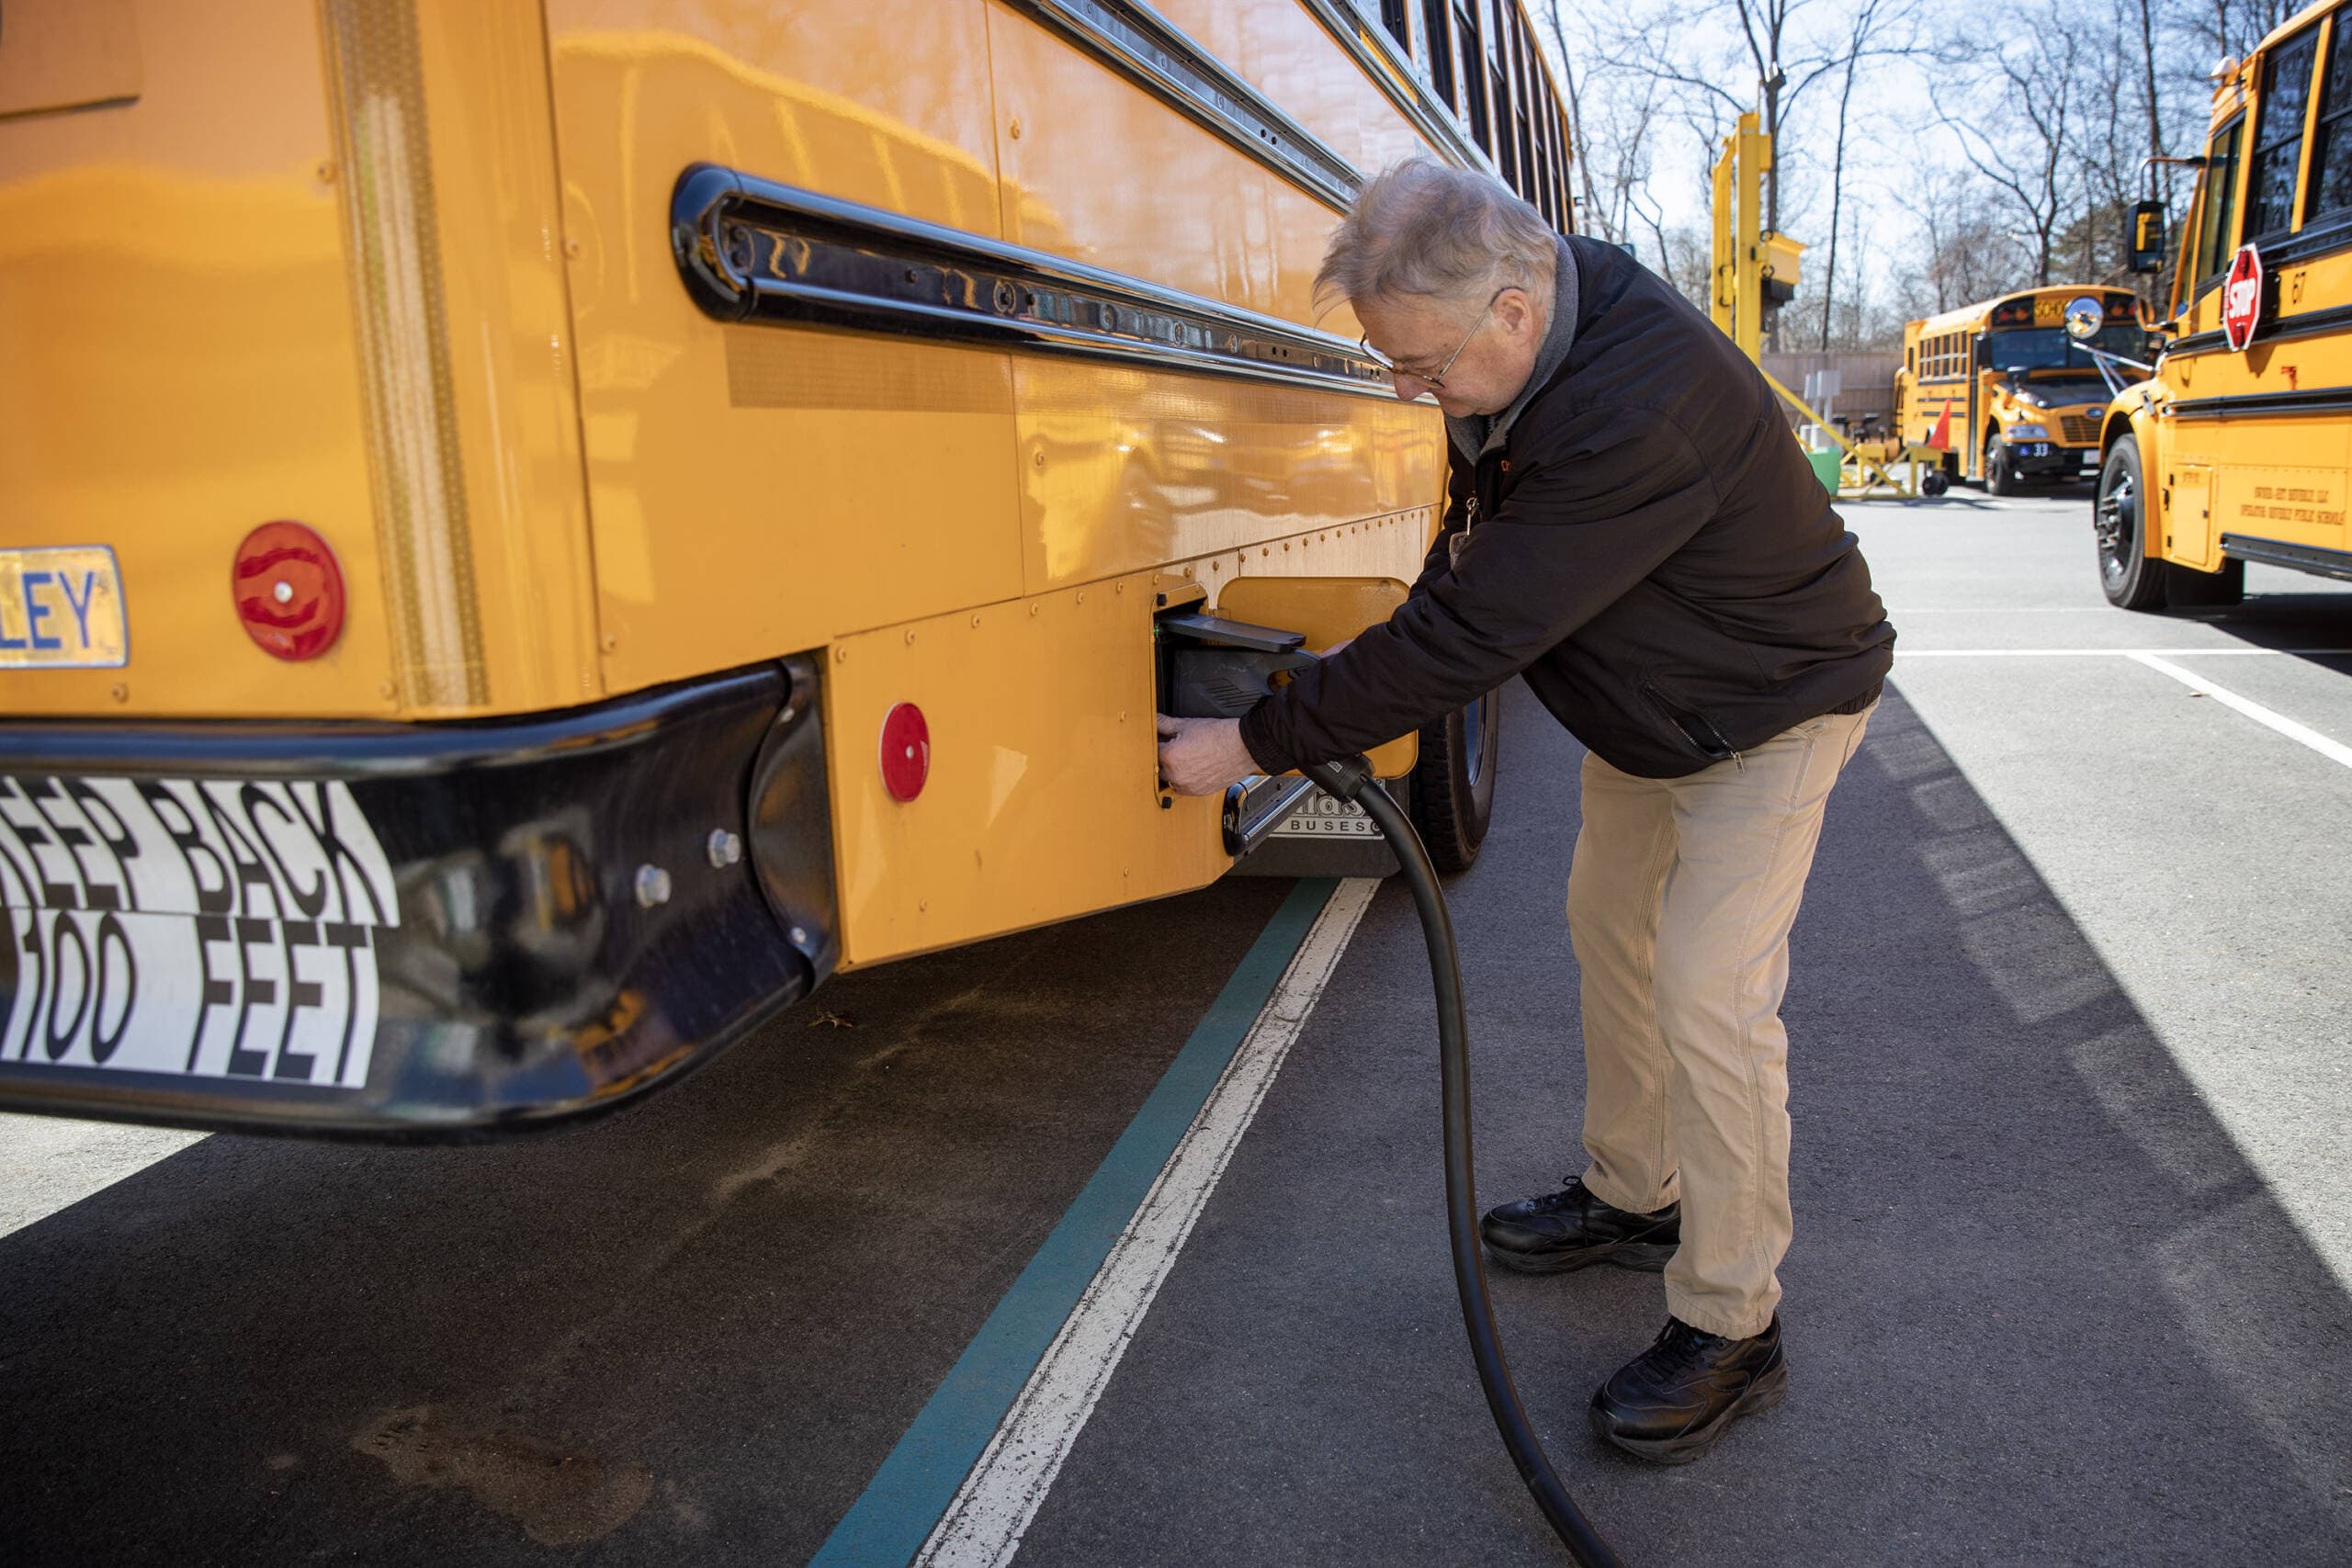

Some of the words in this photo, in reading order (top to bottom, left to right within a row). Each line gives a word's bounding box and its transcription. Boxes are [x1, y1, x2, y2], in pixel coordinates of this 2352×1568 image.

[2229, 277, 2256, 319] STOP
[132, 780, 386, 925] BACK
[1291, 820, 1365, 832] BUSES
[19, 909, 137, 1063] 100
[187, 916, 369, 1086] FEET
